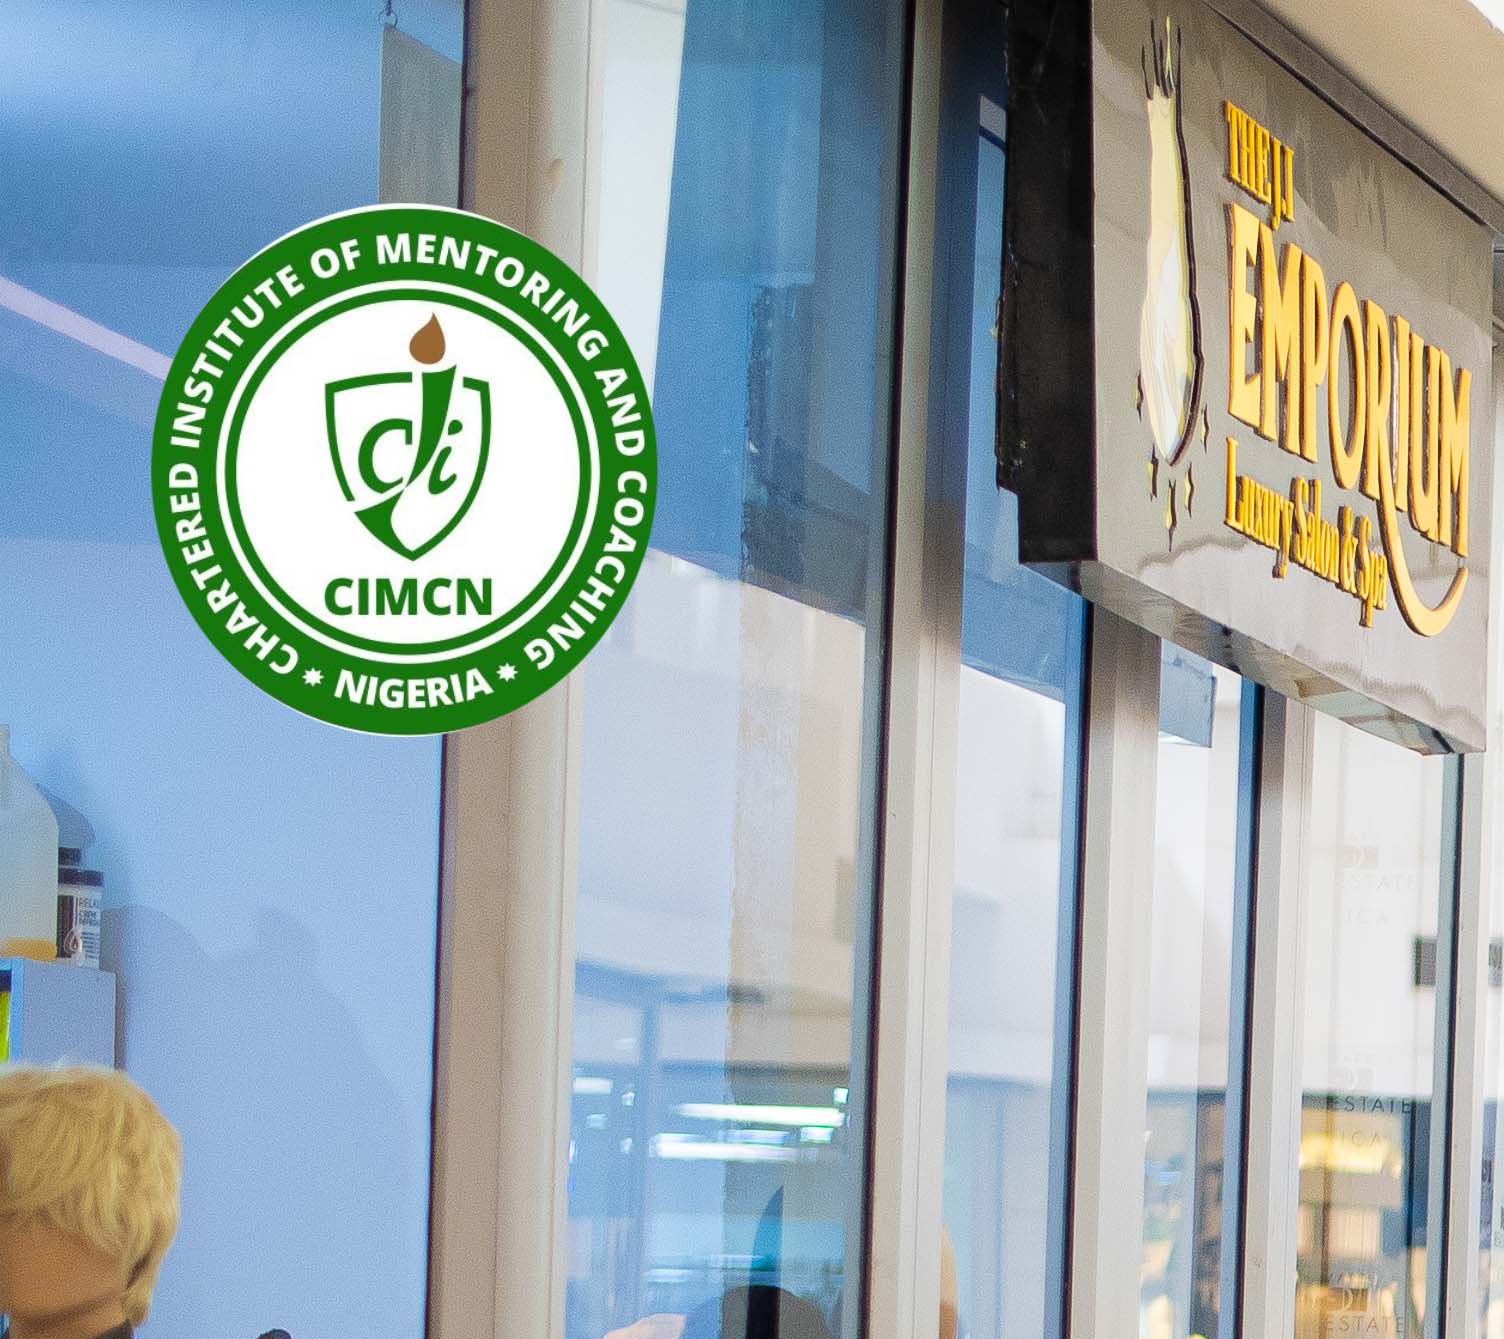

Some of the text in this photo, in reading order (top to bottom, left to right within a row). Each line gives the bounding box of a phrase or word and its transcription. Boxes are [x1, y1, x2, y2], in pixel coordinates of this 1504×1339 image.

[1223, 100, 1271, 205] THE
[1225, 202, 1471, 636] EMPORIUM
[1224, 436, 1294, 578] Luxury
[1289, 476, 1339, 584] Salon
[1356, 516, 1388, 628] Spa
